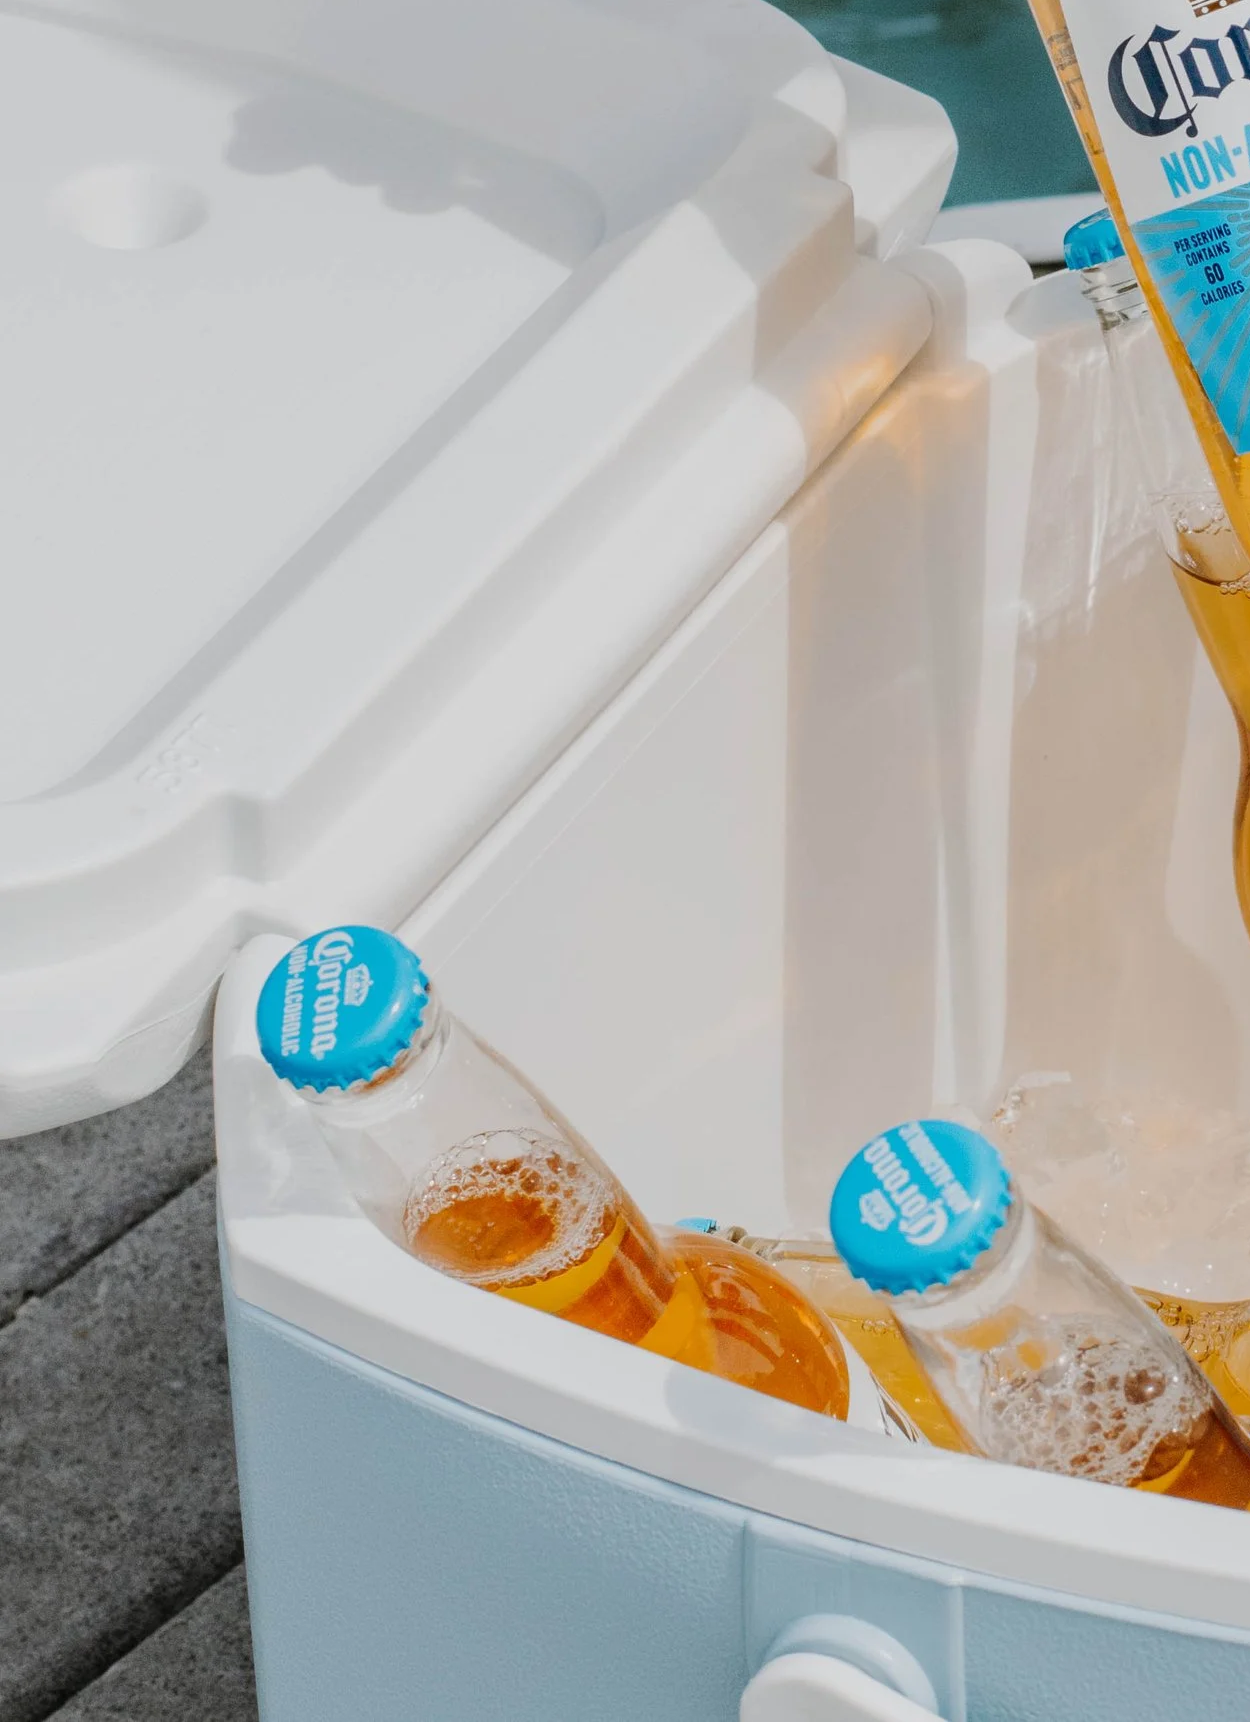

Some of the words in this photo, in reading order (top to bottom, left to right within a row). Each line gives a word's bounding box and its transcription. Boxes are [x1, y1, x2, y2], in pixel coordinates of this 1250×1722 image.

[1173, 238, 1192, 254] PER
[1190, 223, 1232, 248] SERVING
[1185, 240, 1231, 267] CONTAINS
[1203, 262, 1225, 285] 60
[1200, 280, 1245, 306] CALORIES
[308, 930, 355, 1061] Corona
